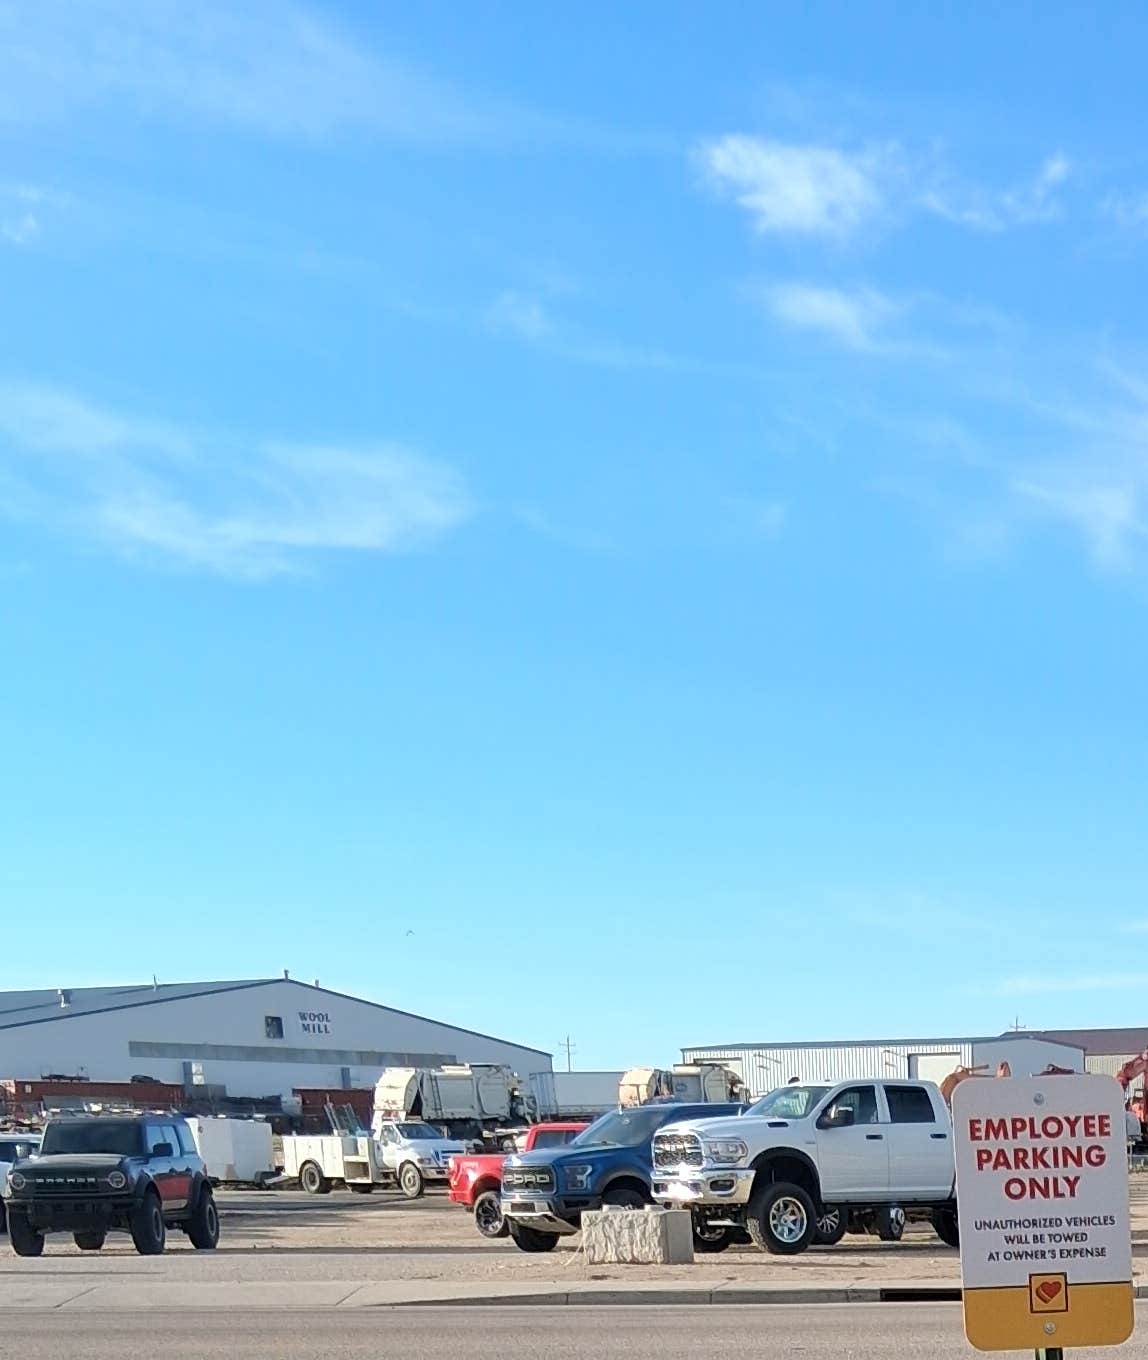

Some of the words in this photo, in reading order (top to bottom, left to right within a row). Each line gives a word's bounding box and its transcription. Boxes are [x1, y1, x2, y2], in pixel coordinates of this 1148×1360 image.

[298, 1011, 331, 1022] WOOL
[302, 1023, 331, 1034] MILL
[969, 1114, 1112, 1141] EMPLOYEE
[976, 1144, 1107, 1171] PARKING
[1004, 1175, 1081, 1200] ONLY
[974, 1217, 1063, 1231] UNAUTHORIZED
[1064, 1215, 1116, 1227] VEHICLES
[1003, 1234, 1031, 1245] WILL
[1032, 1233, 1046, 1244] BE
[1047, 1232, 1089, 1243] TOWED
[987, 1251, 1000, 1262] AT
[1002, 1249, 1057, 1260] OWNER'S
[1059, 1246, 1107, 1259] EXPENSE
